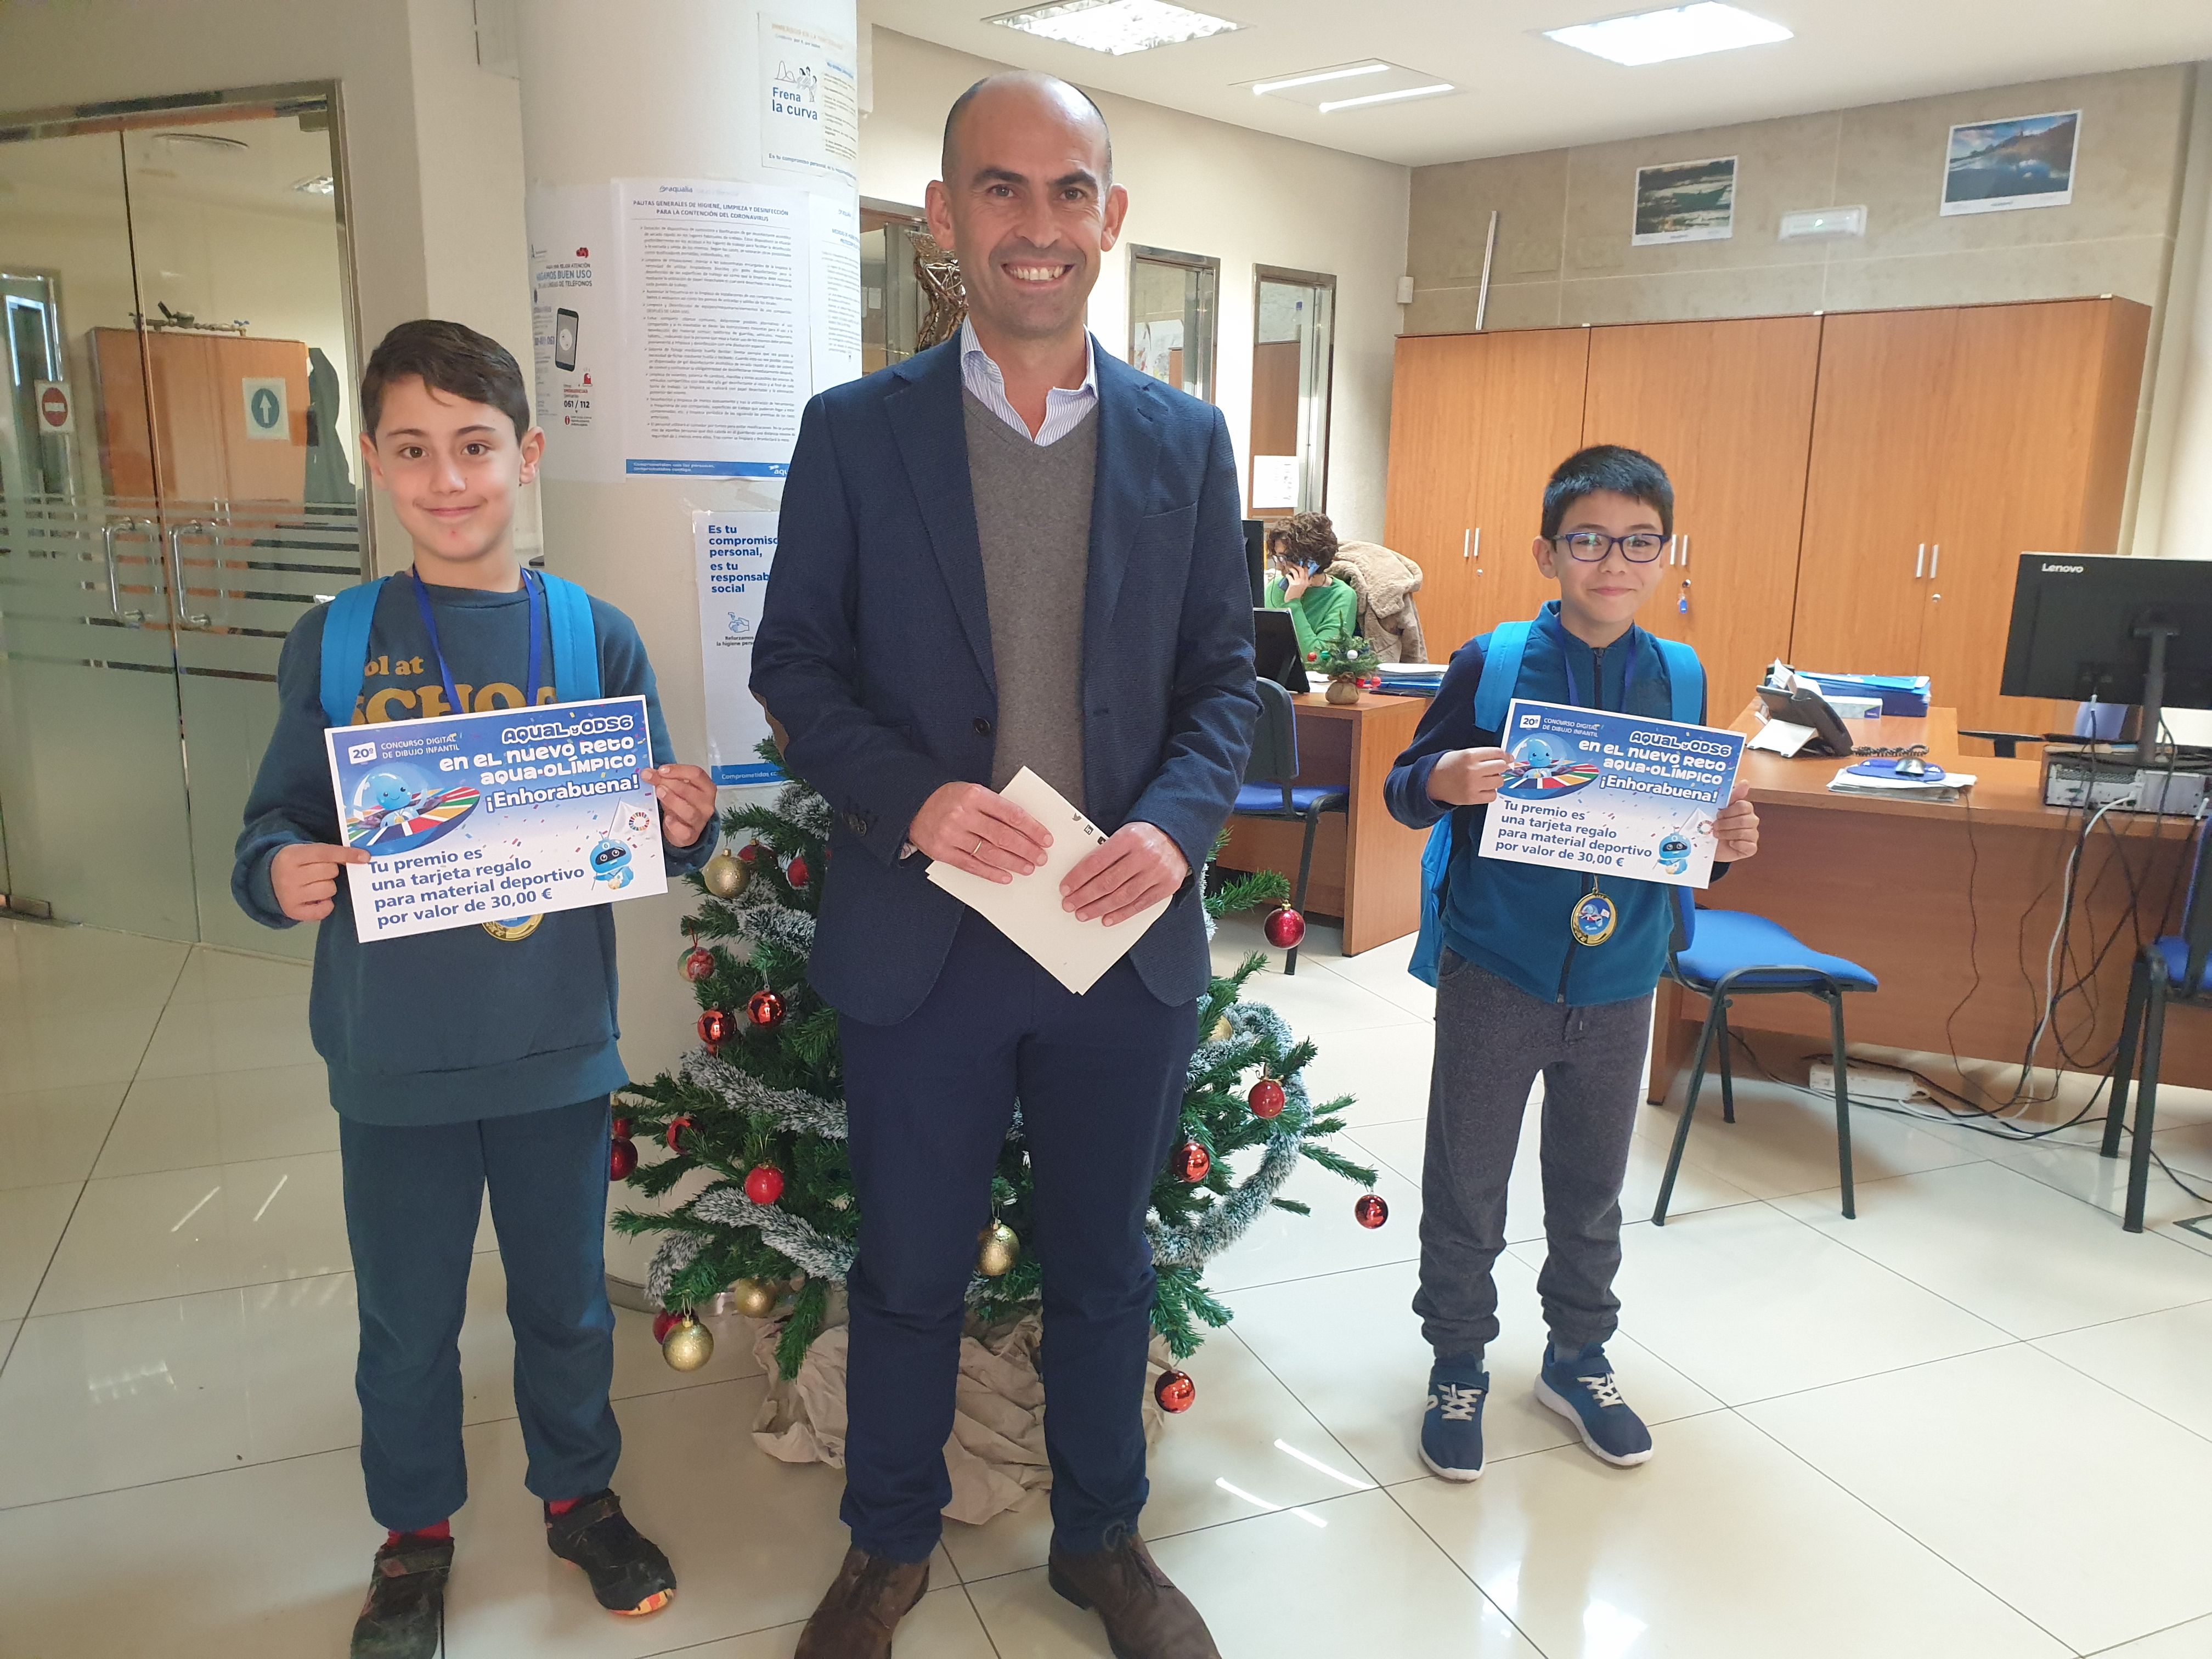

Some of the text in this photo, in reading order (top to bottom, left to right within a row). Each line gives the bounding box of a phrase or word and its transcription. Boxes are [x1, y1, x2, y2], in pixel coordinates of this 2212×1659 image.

[772, 87, 801, 102] Frena
[772, 99, 817, 120] la curva
[730, 213, 769, 222] CORONAVIRUS
[753, 207, 788, 216] DESINFECCIÓN
[557, 269, 575, 279] BUEN
[576, 269, 592, 279] USO
[580, 400, 590, 409] 112
[708, 525, 737, 534] Es tu
[709, 548, 763, 558] personal,
[710, 562, 738, 571] es tu
[2041, 562, 2084, 573] Lenovo
[710, 572, 769, 583] responsab
[711, 584, 745, 593] social
[364, 655, 425, 677] ol at
[580, 714, 634, 733] ODS6
[1543, 718, 1598, 731] CONCURSO DIGITAL
[1551, 725, 1572, 734] DIBUJO
[381, 735, 456, 751] CONCURSO DIGITAL
[1578, 740, 1601, 753] en
[1690, 740, 1733, 757] ODS6
[382, 744, 460, 759] DE DIBUJO INFANTIL
[439, 755, 469, 772] en
[721, 771, 769, 780] Comprometidos
[486, 773, 640, 814] ¡Enhorabuena!
[1599, 774, 1718, 803] ¡Enhorabuena!
[1504, 800, 1585, 821] Tu premio es
[1501, 814, 1617, 839] una tarjeta regalo
[1498, 827, 1652, 857] para material deportivo
[369, 848, 483, 874] Tu premio es
[1495, 840, 1625, 867] por valor de 30,00 €
[372, 857, 532, 892] una tarjeta regalo
[375, 866, 585, 912] para material deportivo
[377, 888, 553, 929] por valor de 30,00 €
